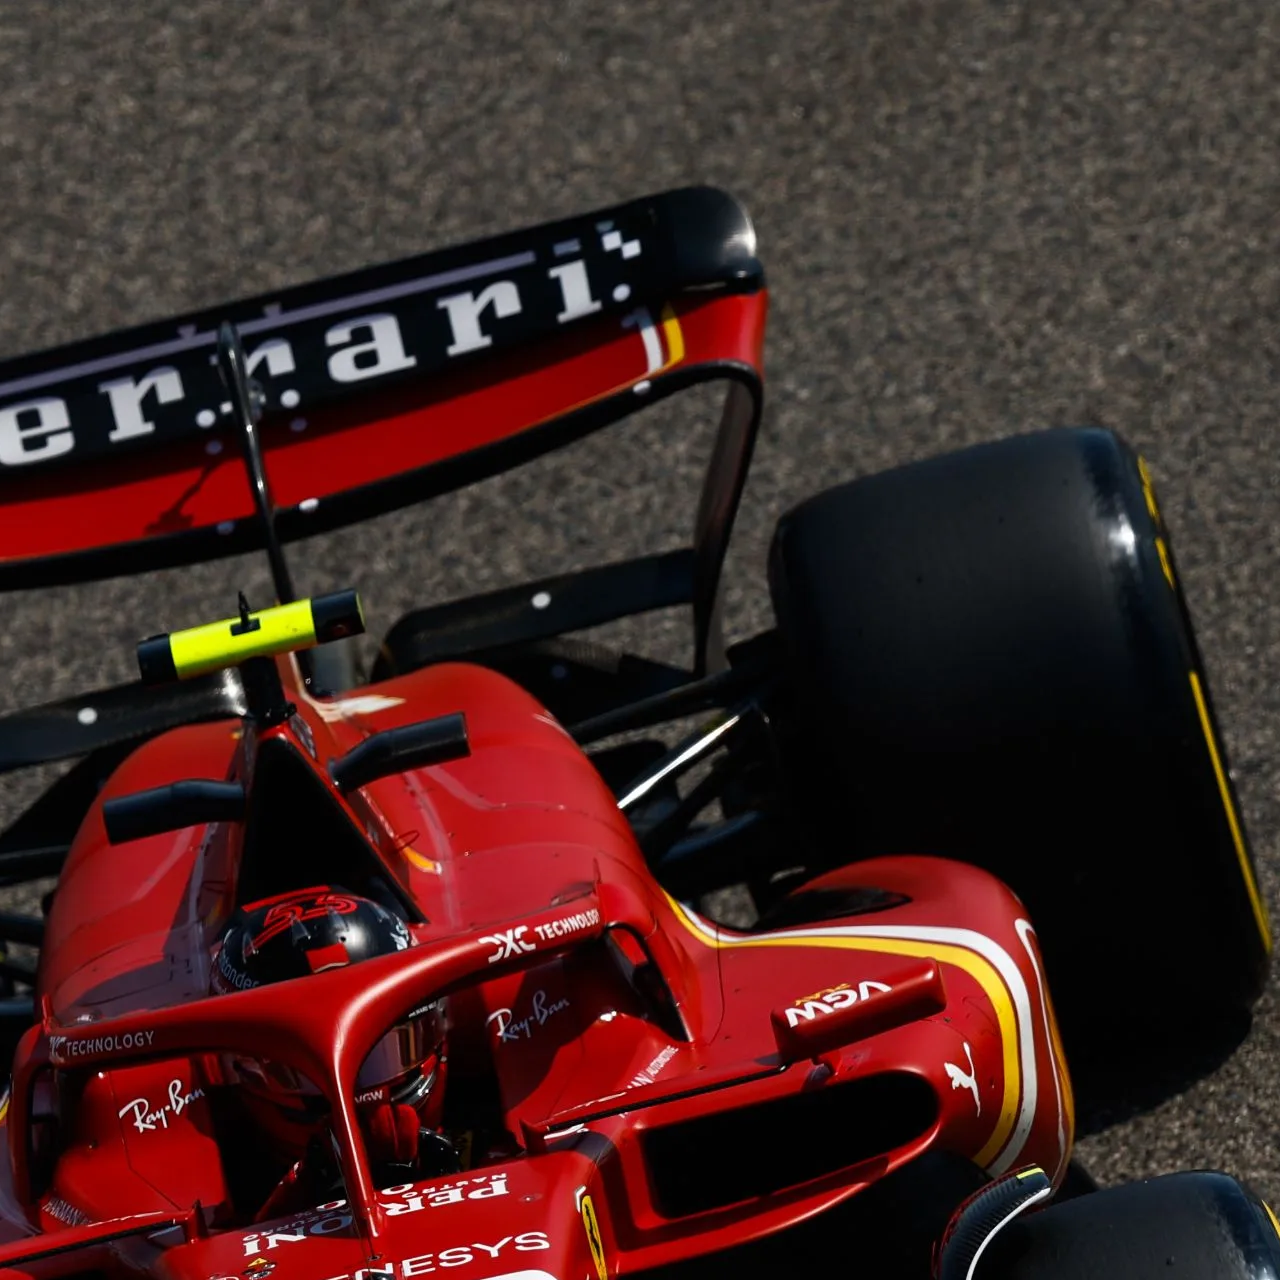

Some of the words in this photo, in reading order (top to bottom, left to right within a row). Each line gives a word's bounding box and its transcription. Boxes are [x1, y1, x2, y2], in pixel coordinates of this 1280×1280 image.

[477, 924, 537, 964] DXC
[485, 990, 570, 1042] Ray-Ban
[784, 980, 893, 1028] VGW
[66, 1031, 155, 1058] TECHNOLOGY
[118, 1079, 206, 1134] Ray-Ban
